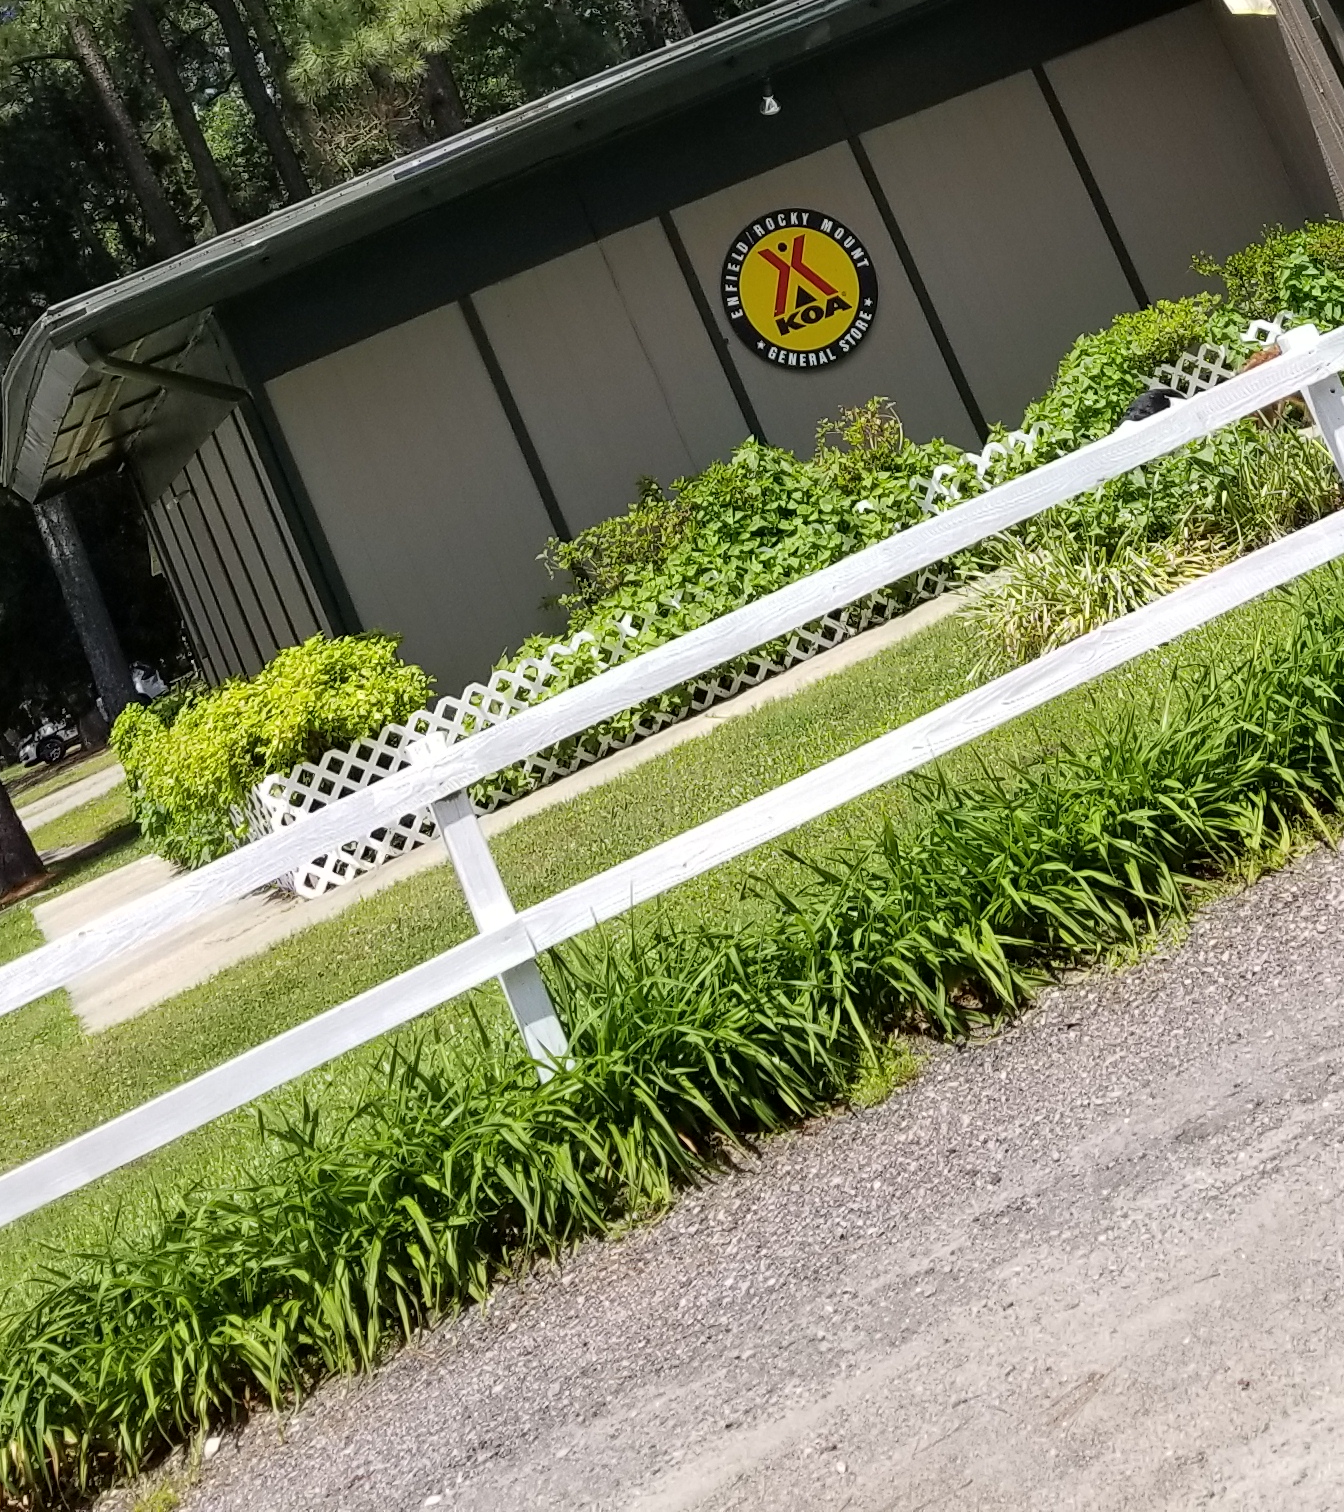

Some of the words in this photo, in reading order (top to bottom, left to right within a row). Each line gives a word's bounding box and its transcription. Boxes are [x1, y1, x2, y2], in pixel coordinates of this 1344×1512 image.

[820, 218, 870, 268] MOUNT
[768, 346, 837, 367] GENERAL
[838, 311, 873, 352] STORE
[775, 295, 853, 337] KOA
